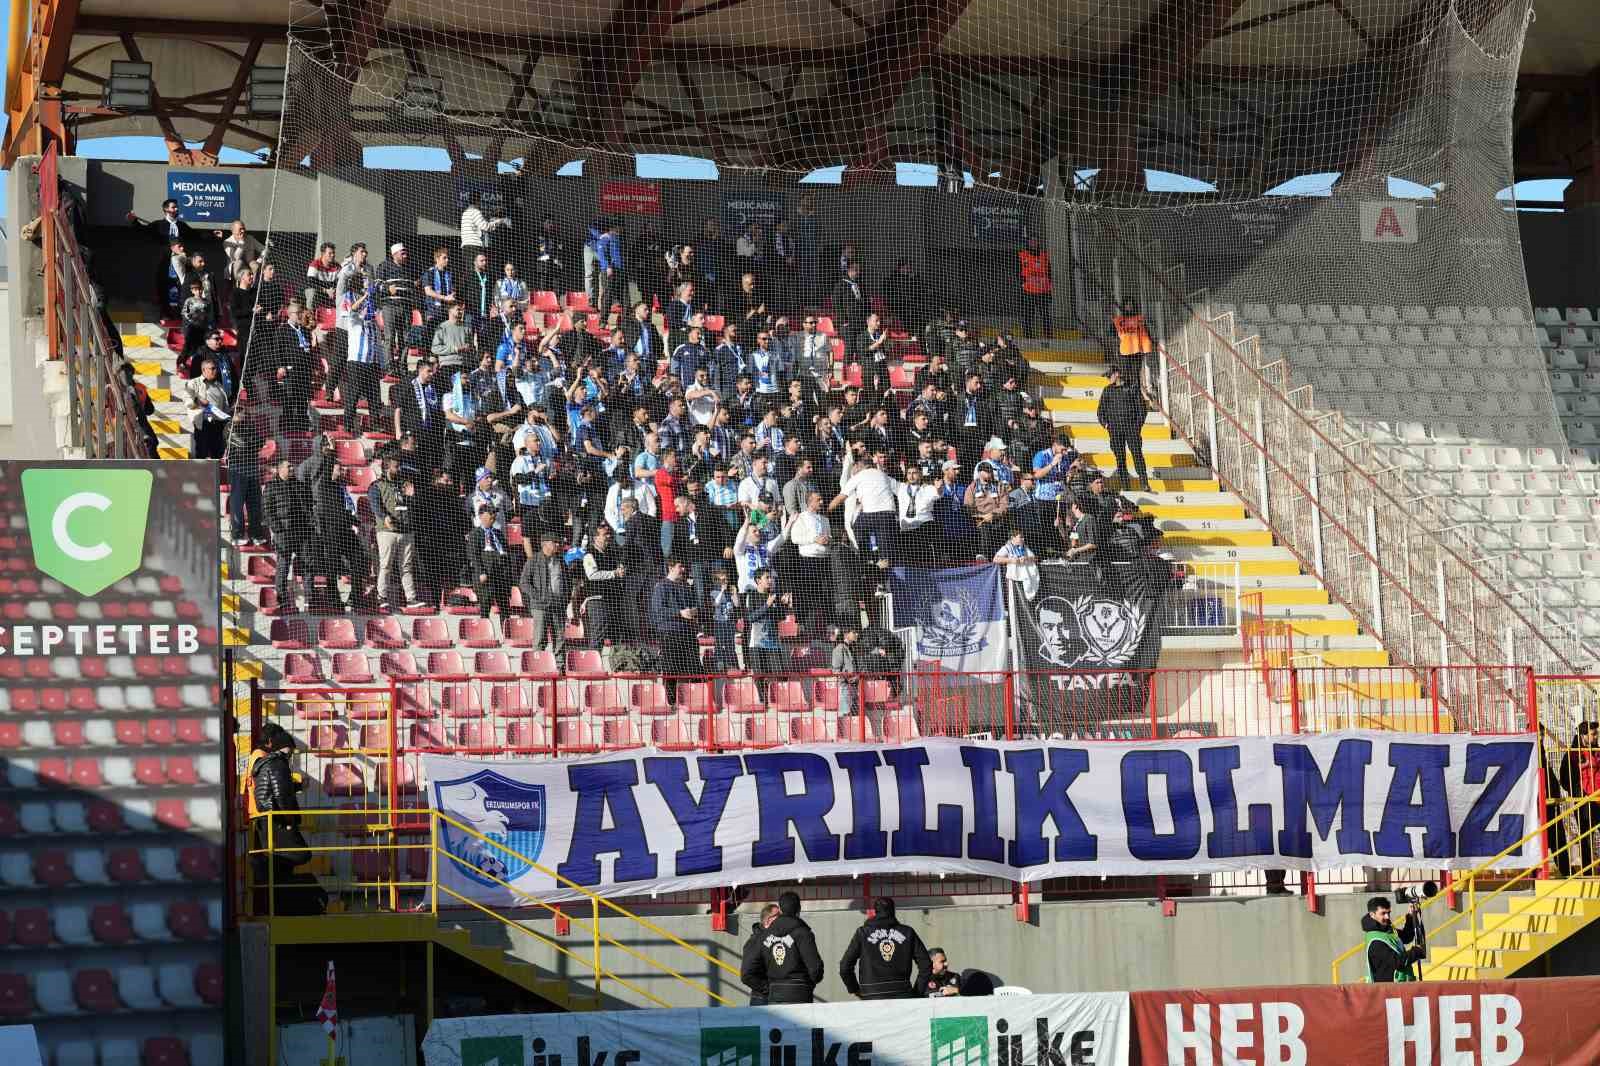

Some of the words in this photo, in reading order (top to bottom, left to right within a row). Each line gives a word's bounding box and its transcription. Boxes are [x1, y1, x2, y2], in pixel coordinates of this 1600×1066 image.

[173, 182, 226, 192] MEDICANA
[1375, 207, 1404, 237] A
[52, 491, 113, 561] C
[0, 624, 200, 656] EPTETEB
[1050, 672, 1132, 690] TAYFA
[557, 746, 1098, 889] AYRILIK
[1120, 738, 1533, 861] OLMAZ
[1165, 1002, 1308, 1066] HEB
[1385, 993, 1525, 1066] HEB
